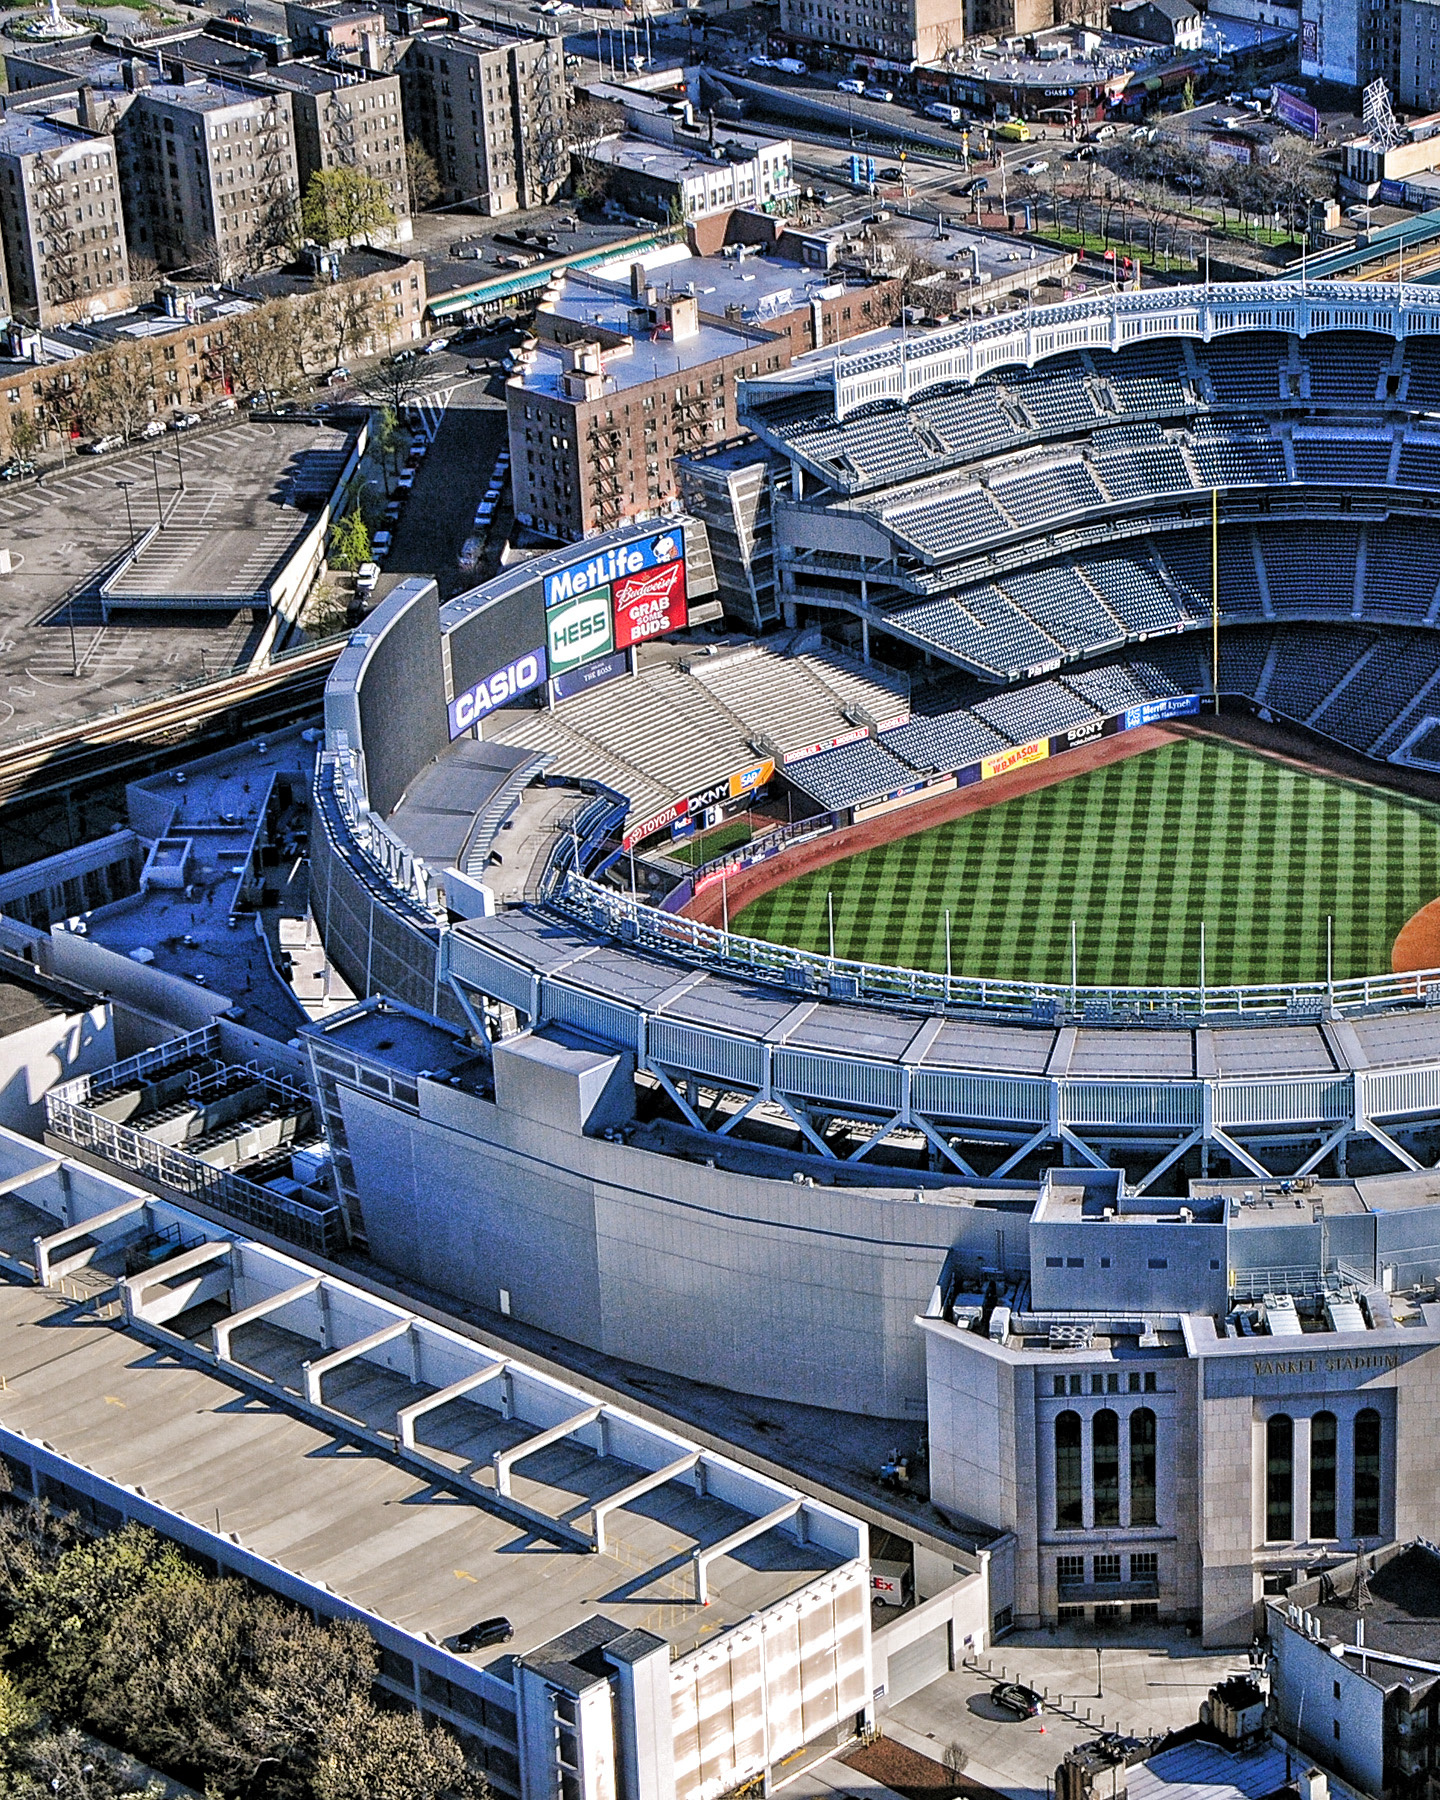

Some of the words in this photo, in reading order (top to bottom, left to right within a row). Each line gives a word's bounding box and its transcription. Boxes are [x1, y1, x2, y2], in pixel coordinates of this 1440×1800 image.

[1044, 89, 1067, 97] CHASE
[551, 547, 644, 605] MetLife
[615, 576, 678, 605] Budweiser
[629, 596, 670, 620] GRAB
[636, 610, 663, 625] SOME
[554, 611, 606, 648] HESS
[631, 616, 670, 640] BUDS
[597, 664, 612, 677] BOSS
[455, 655, 538, 729] CASIO
[1168, 698, 1191, 710] Lynch
[1067, 720, 1105, 741] SONY
[741, 772, 758, 786] SAP
[688, 783, 729, 811] DKNY
[642, 807, 677, 834] TOYOTA
[1253, 1359, 1318, 1376] YANKEE
[1325, 1353, 1399, 1372] STADIUM
[870, 1577, 894, 1591] dEx
